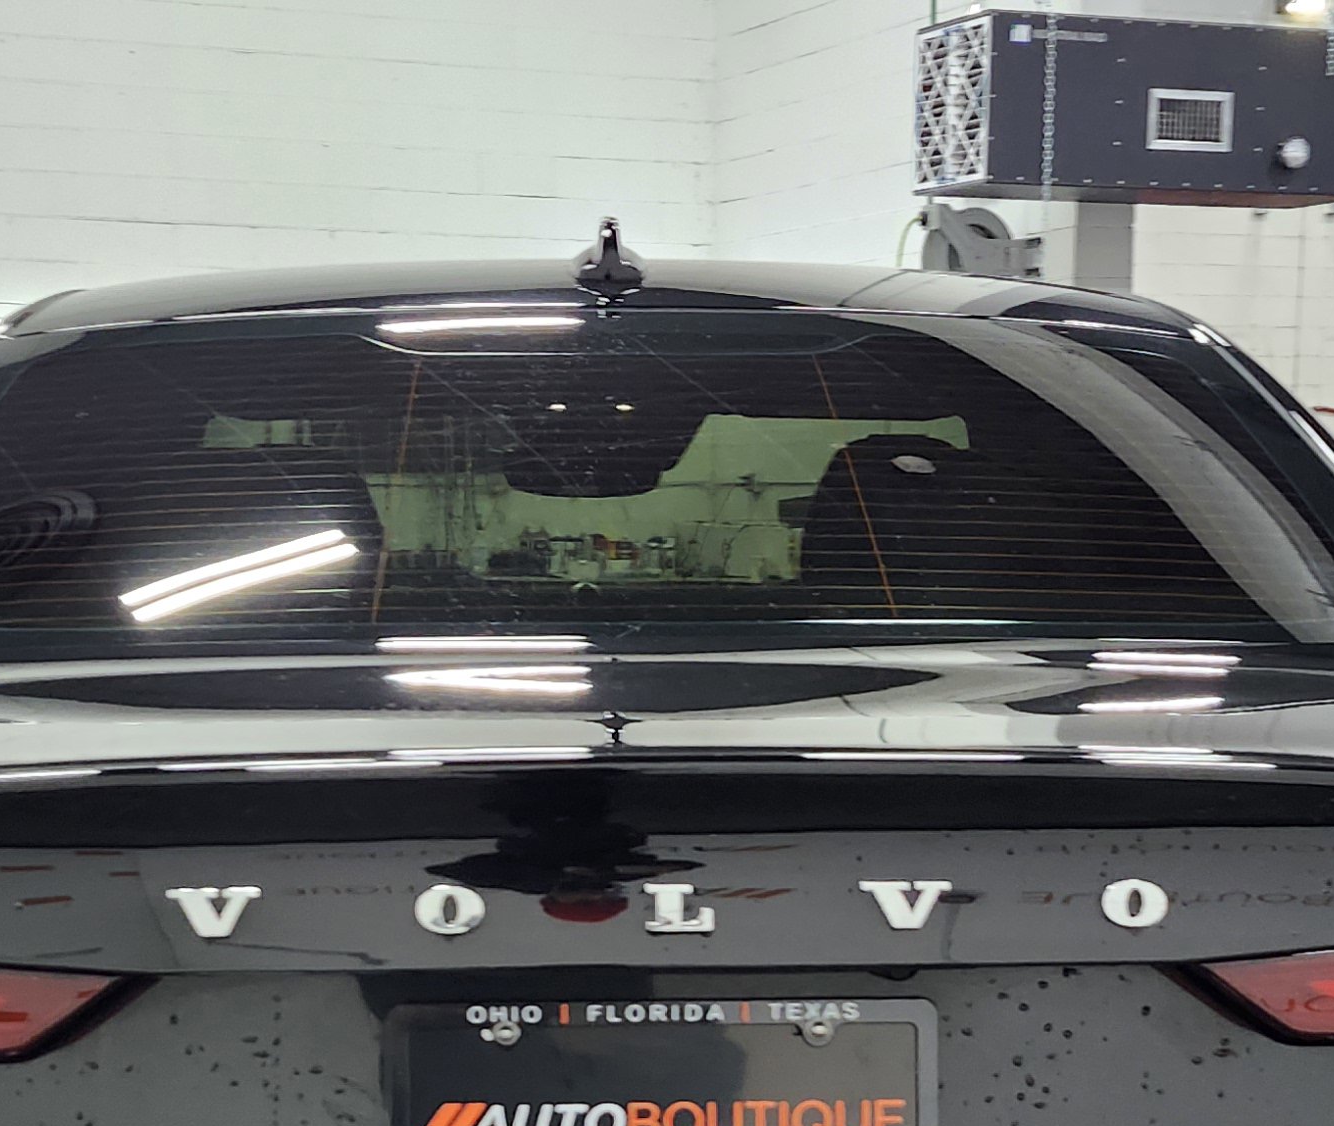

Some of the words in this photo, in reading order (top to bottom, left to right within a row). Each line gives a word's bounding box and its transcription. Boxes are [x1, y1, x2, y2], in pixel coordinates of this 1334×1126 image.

[165, 878, 1170, 939] VOLVO
[466, 1004, 544, 1025] OHIO
[585, 1003, 727, 1023] FLORIDA
[767, 1001, 861, 1021] TEXAS
